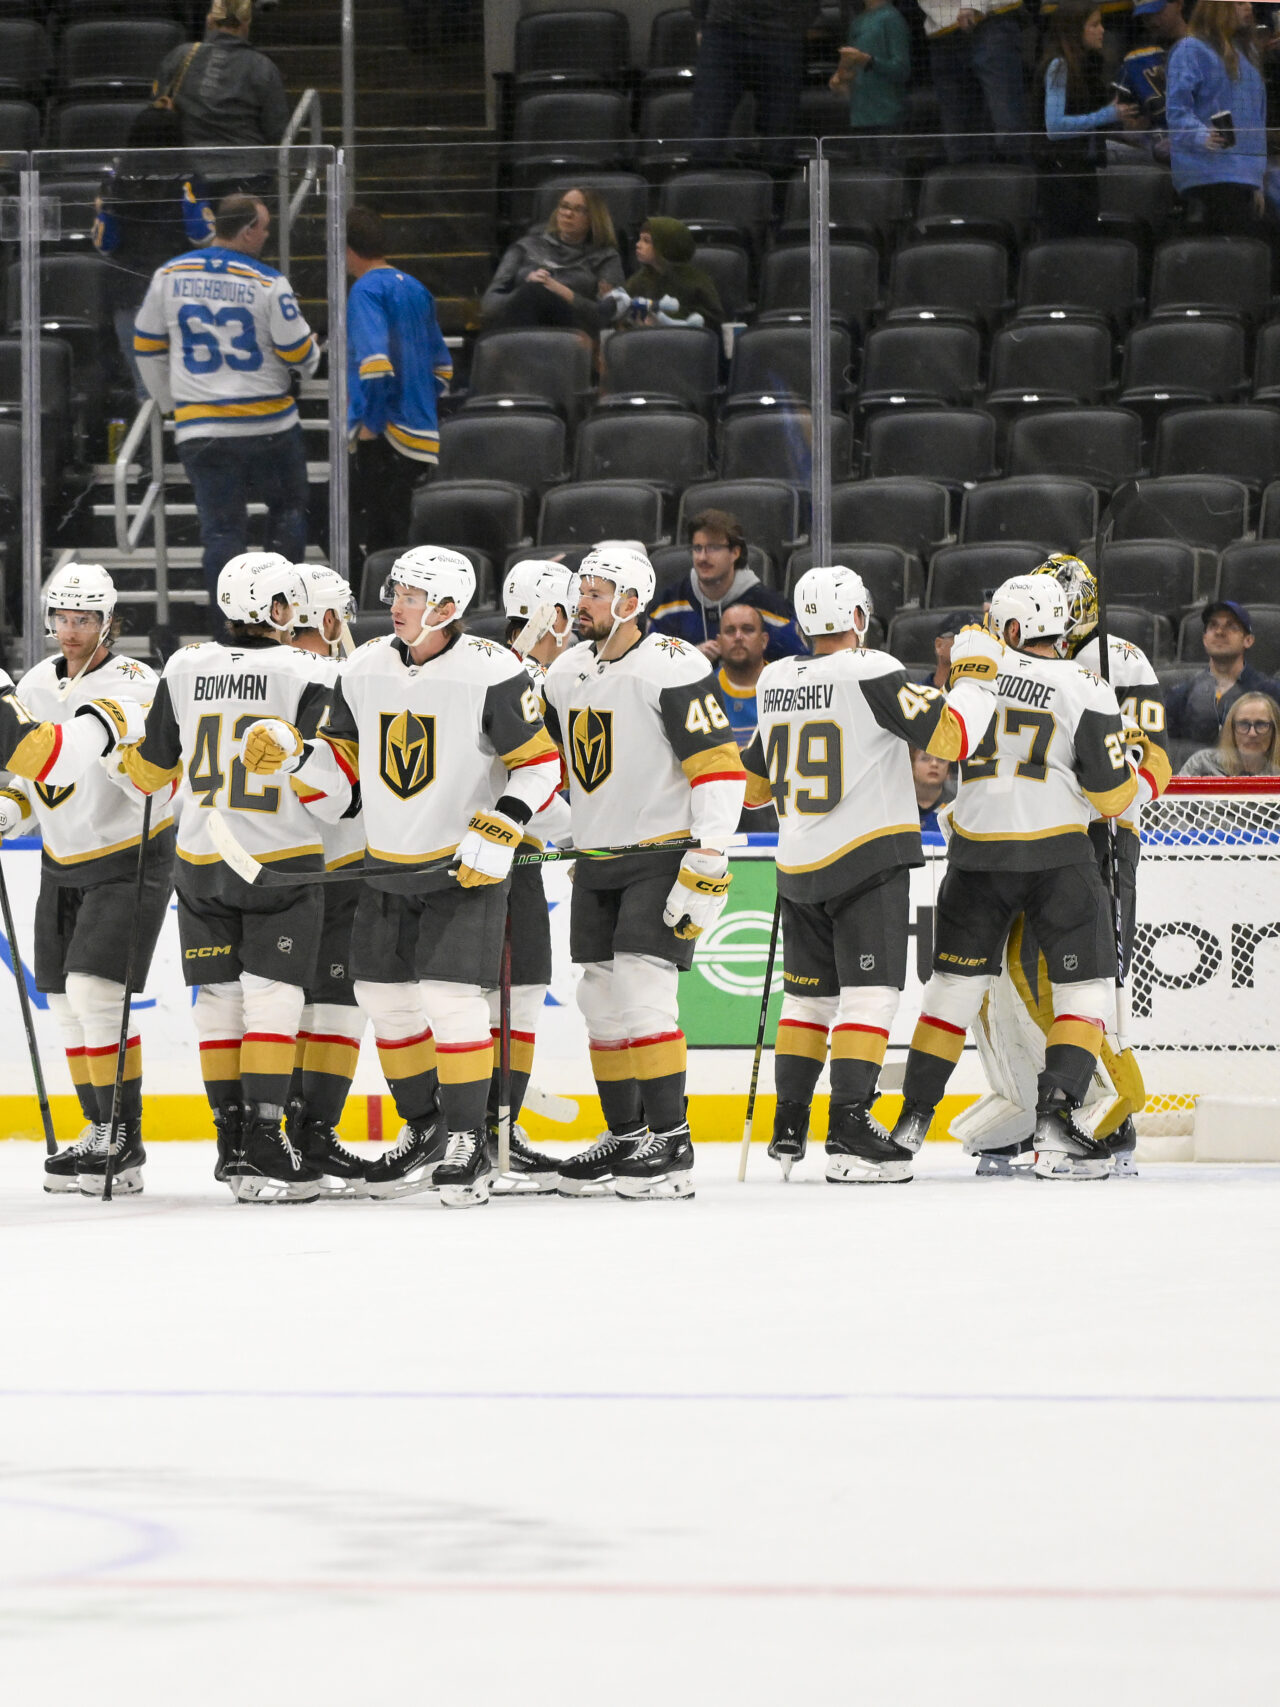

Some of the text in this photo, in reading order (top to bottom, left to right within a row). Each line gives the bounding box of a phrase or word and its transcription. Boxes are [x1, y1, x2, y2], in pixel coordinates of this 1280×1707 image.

[172, 278, 257, 305] NEIGHBOURS
[278, 293, 302, 321] 6
[178, 304, 264, 375] 63
[221, 592, 231, 604] 42
[805, 603, 817, 615] 49
[1053, 606, 1064, 618] 27
[194, 674, 268, 701] BOWMAN
[763, 684, 834, 714] BARBASHEV
[996, 673, 1056, 709] EODORE
[685, 693, 730, 734] 48
[188, 713, 282, 814] 42
[766, 719, 844, 818] 49
[185, 945, 232, 959] CCM
[938, 952, 988, 967] BAUER
